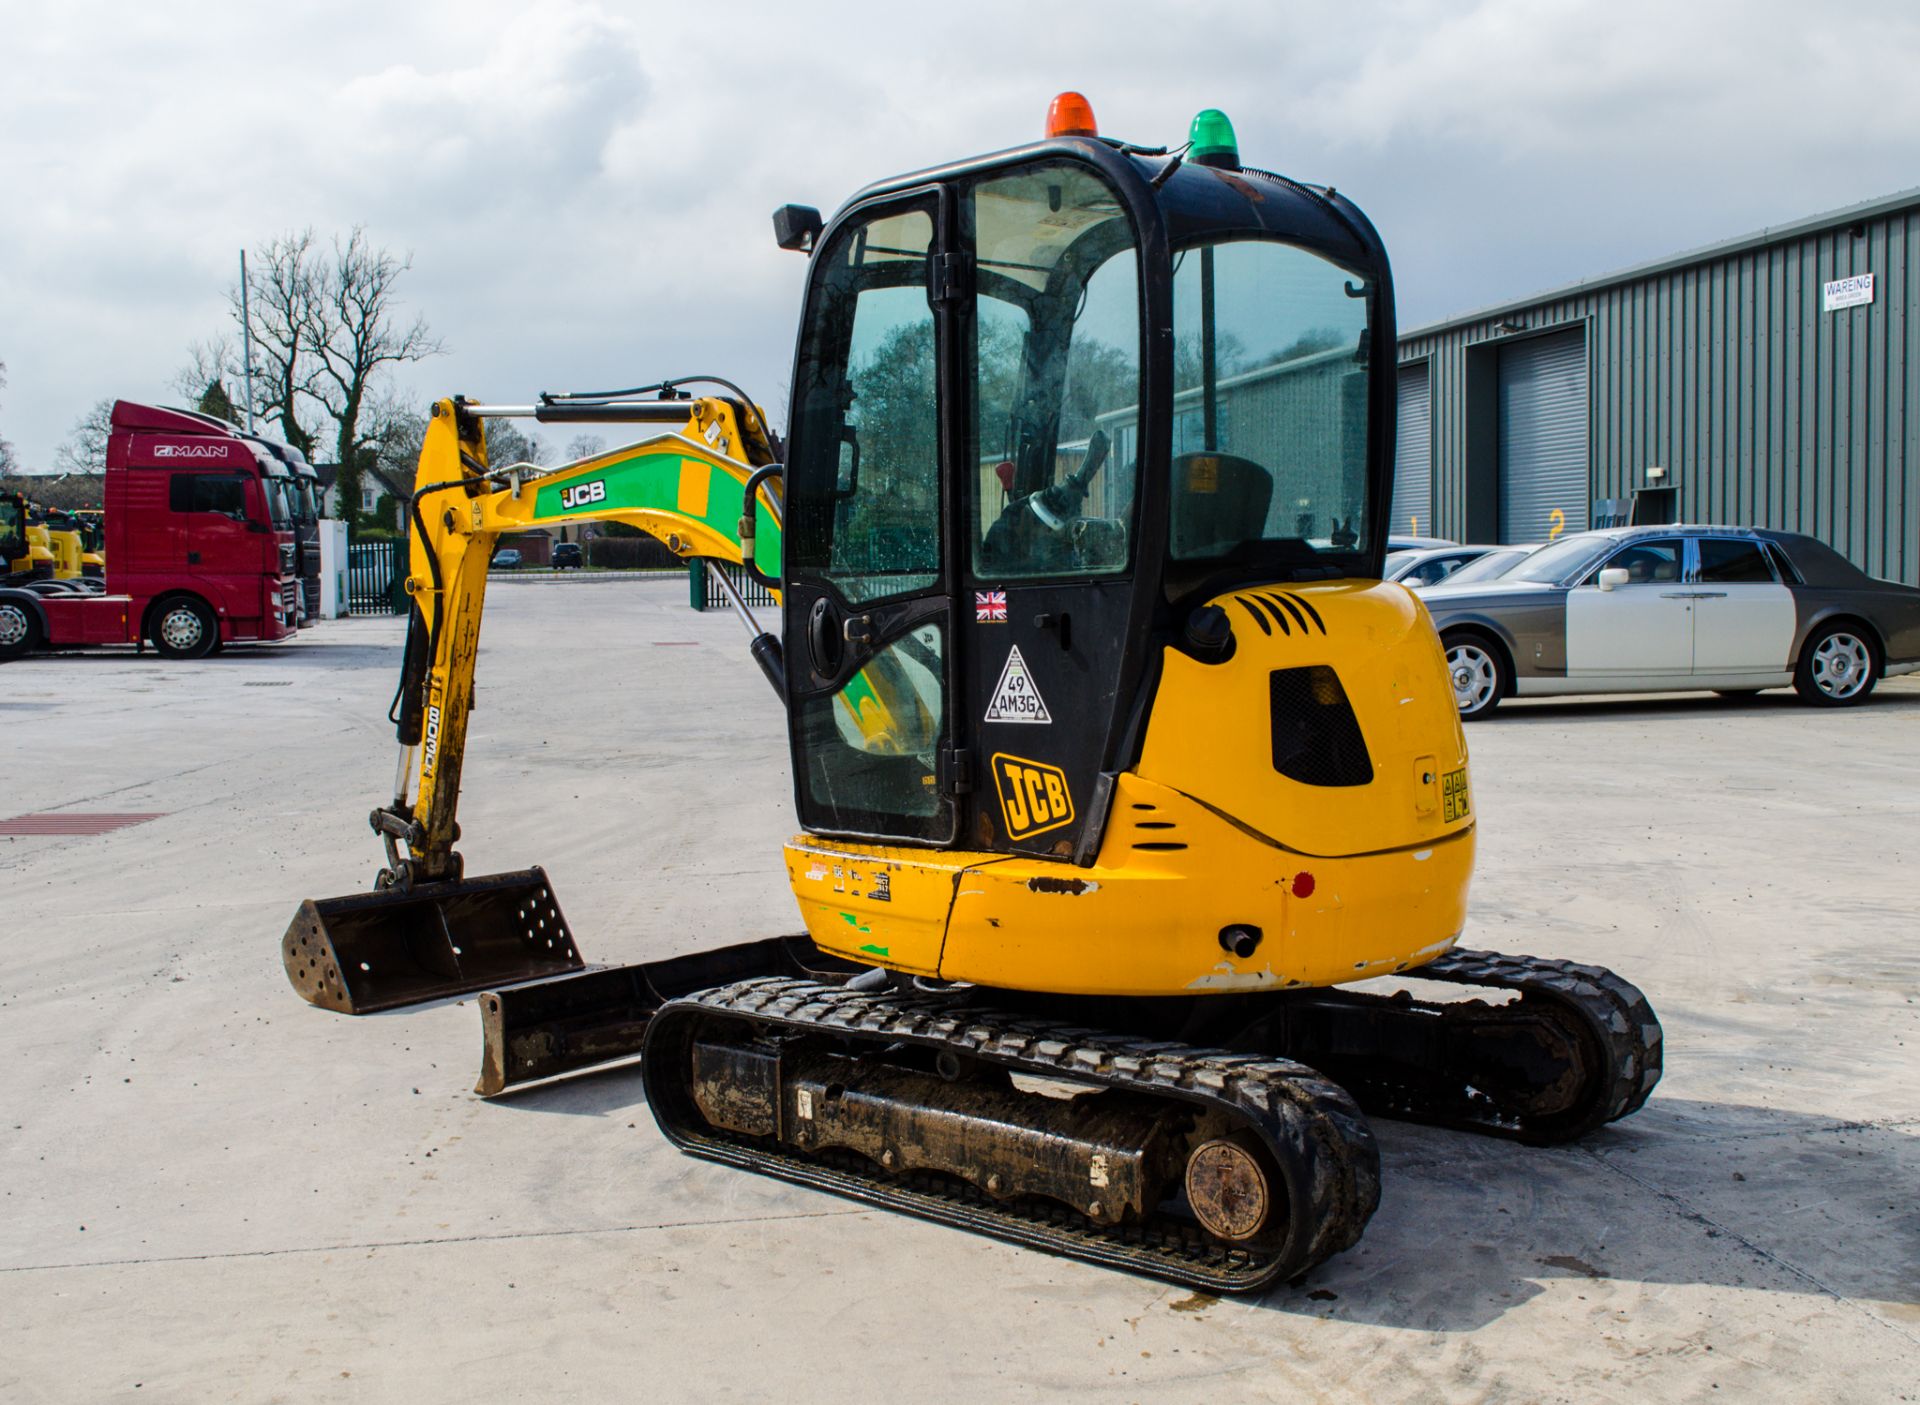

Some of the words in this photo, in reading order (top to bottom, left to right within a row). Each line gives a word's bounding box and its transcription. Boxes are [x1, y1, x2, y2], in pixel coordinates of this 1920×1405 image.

[1827, 276, 1871, 296] WAREING
[171, 445, 228, 457] MAN
[561, 480, 606, 509] JCB
[1549, 507, 1565, 542] 2
[1008, 676, 1025, 693] 49
[999, 695, 1036, 713] AM3G
[1003, 763, 1067, 831] JCB
